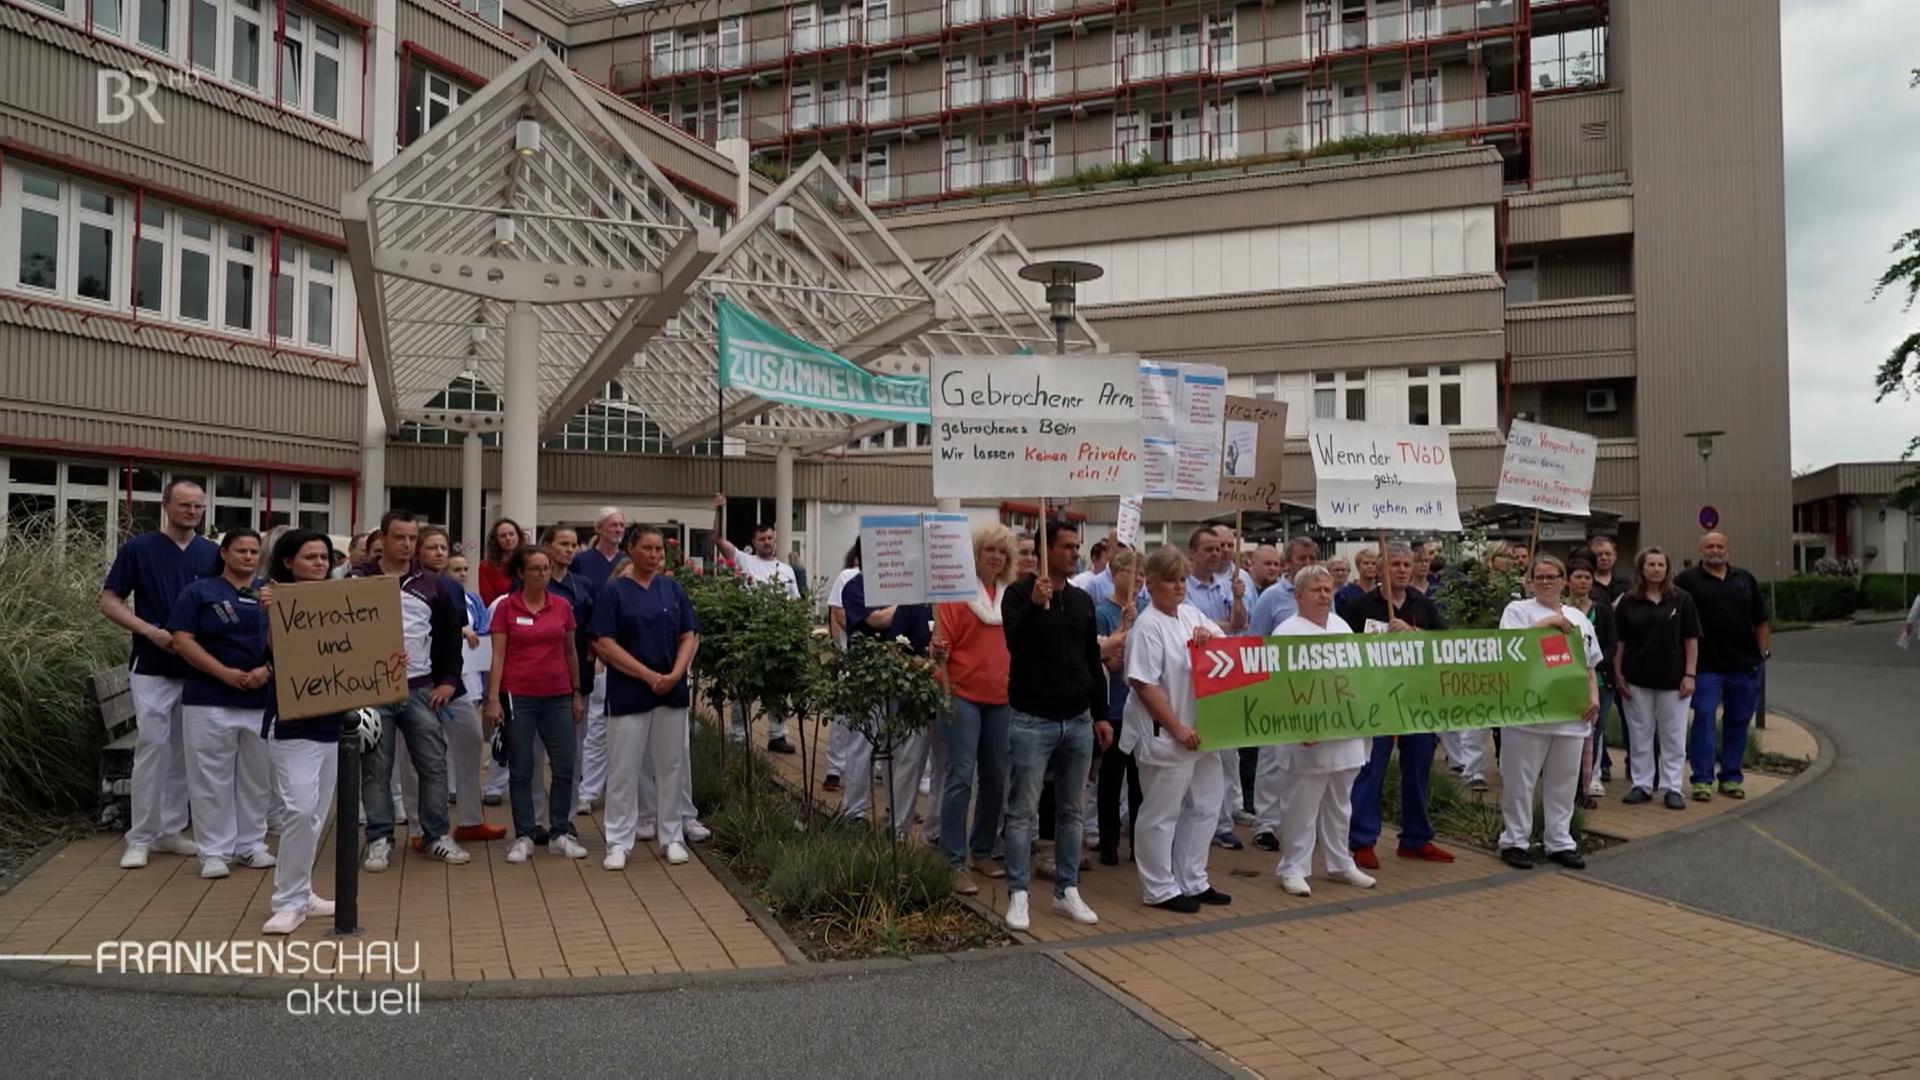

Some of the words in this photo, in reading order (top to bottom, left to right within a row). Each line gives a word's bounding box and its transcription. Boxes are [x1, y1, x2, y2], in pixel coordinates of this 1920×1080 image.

[728, 348, 867, 402] ZUSAMMEN
[871, 379, 930, 407] GEH
[941, 370, 1084, 408] Gebrochener
[1099, 382, 1134, 408] Arm
[1039, 419, 1076, 436] Bein
[974, 444, 1015, 460] lassen
[1078, 442, 1137, 462] Privaten
[1316, 433, 1365, 466] Wenn
[1369, 440, 1391, 466] der
[1372, 499, 1408, 520] gehen
[277, 595, 380, 635] Verraten
[317, 632, 353, 656] und
[1240, 644, 1280, 674] WIR
[1288, 642, 1362, 672] LASSEN
[1366, 640, 1425, 668] NICHT
[1432, 637, 1502, 665] LOCKER!
[1288, 675, 1356, 706] WIR
[1439, 671, 1510, 697] FORDERN
